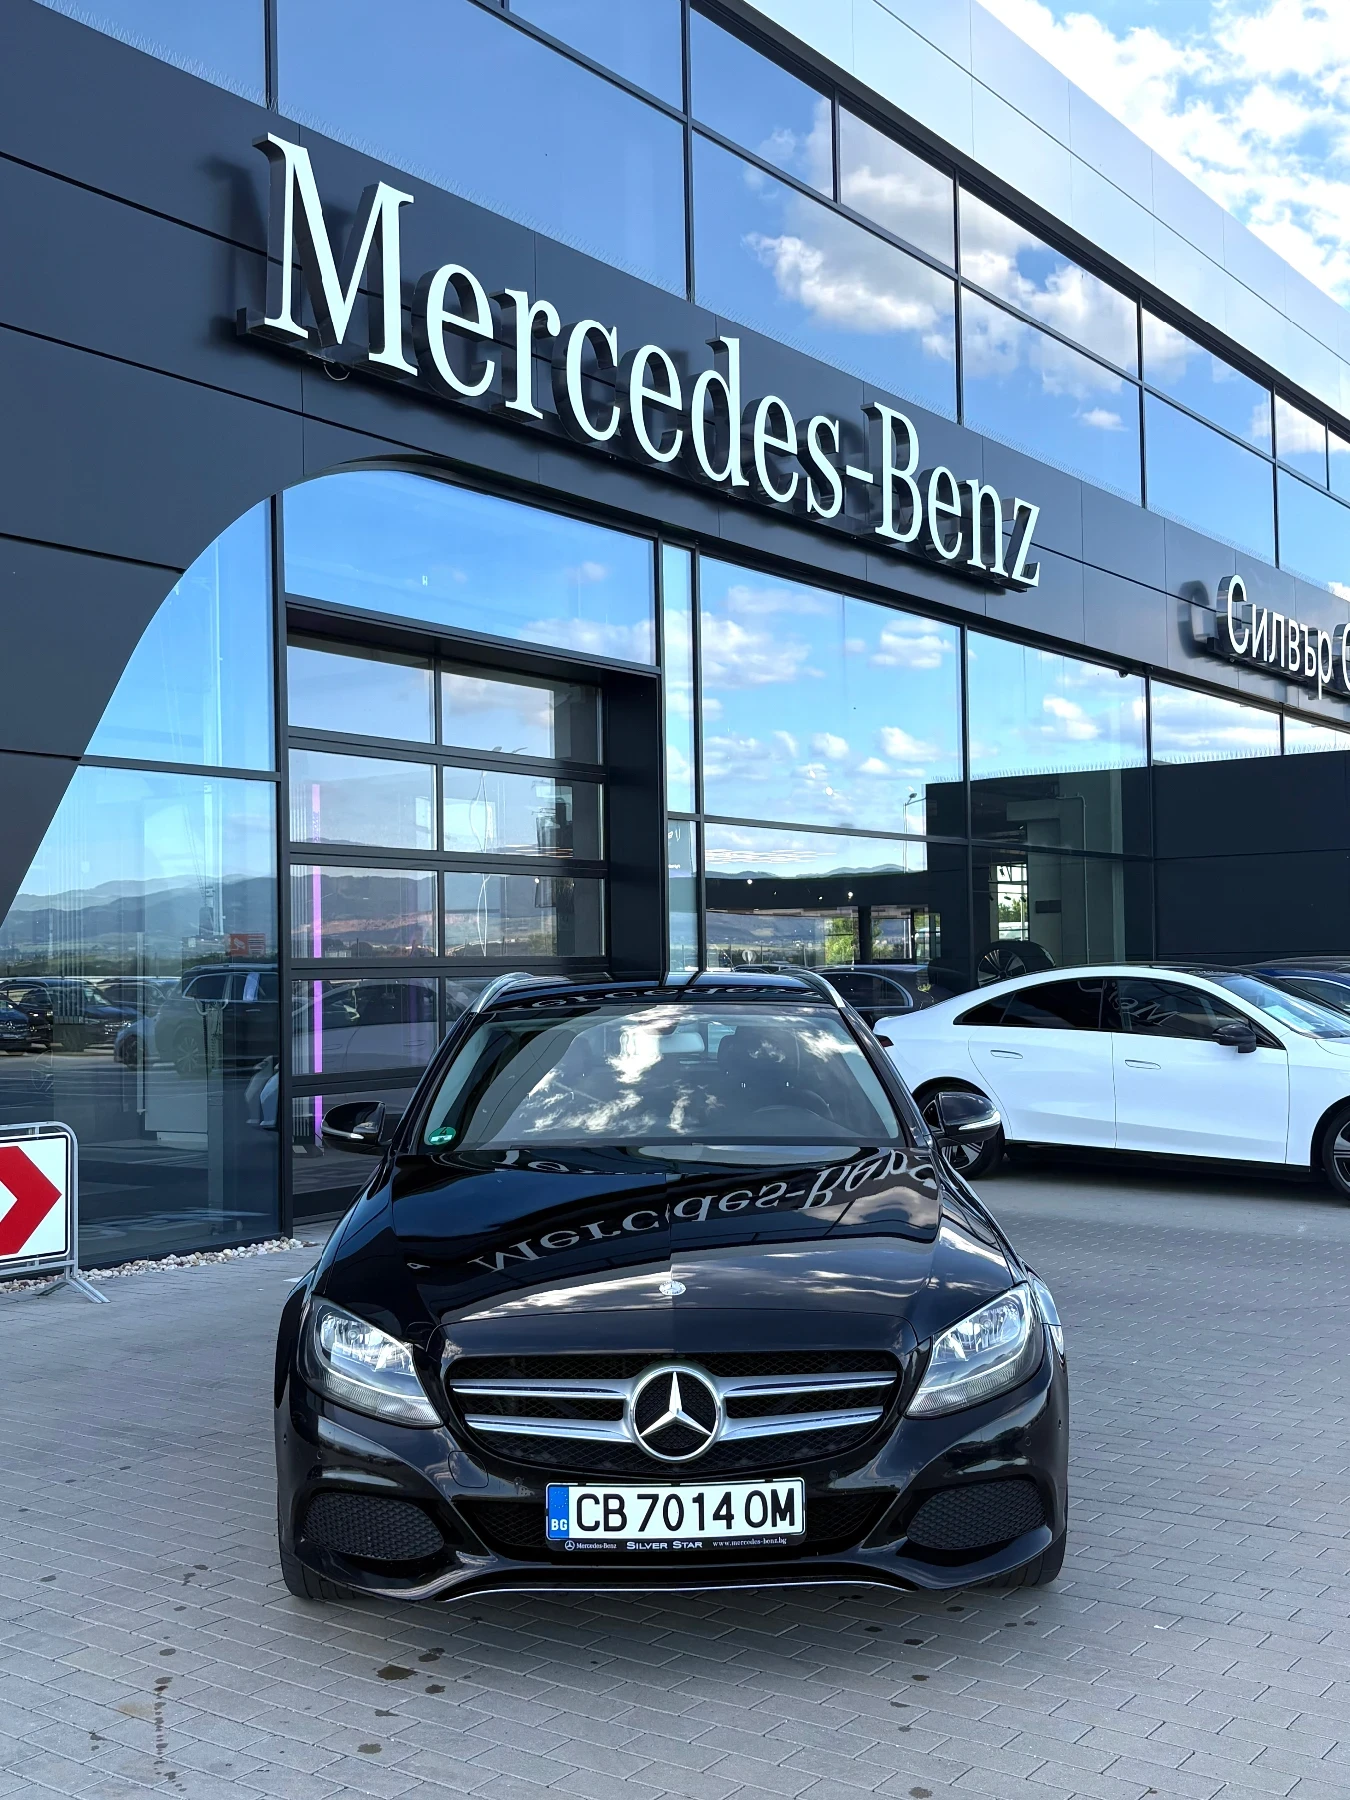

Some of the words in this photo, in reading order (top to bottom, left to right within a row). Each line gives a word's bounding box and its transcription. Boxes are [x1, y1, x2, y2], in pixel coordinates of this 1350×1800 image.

[263, 132, 1042, 588] Mercedes-Benz
[1227, 574, 1333, 700] Силвър
[551, 1518, 568, 1531] BG
[576, 1493, 628, 1532] CB
[636, 1491, 735, 1532] 7014
[744, 1487, 796, 1529] OM
[576, 1542, 618, 1550] Mercedes-Benz
[626, 1541, 668, 1550] SILVER
[672, 1540, 703, 1549] STAR
